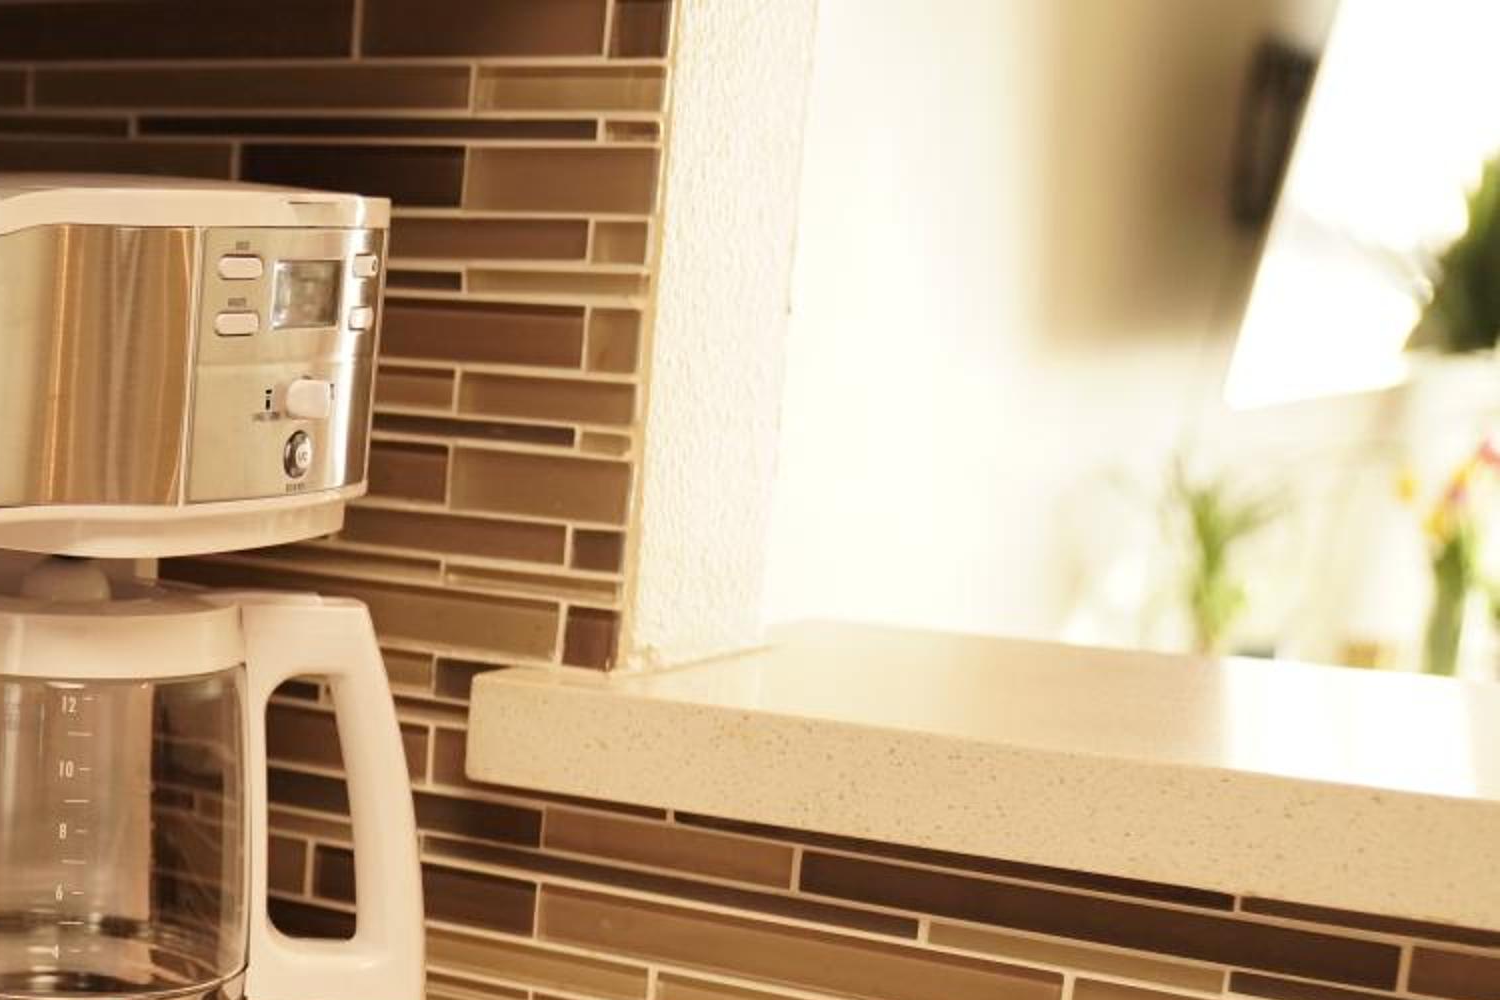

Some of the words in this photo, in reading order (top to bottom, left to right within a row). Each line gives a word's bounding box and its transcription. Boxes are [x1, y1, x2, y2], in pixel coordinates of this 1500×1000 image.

[61, 695, 77, 713] 12
[59, 761, 75, 778] 10
[59, 823, 68, 839] 8
[55, 884, 64, 900] 6
